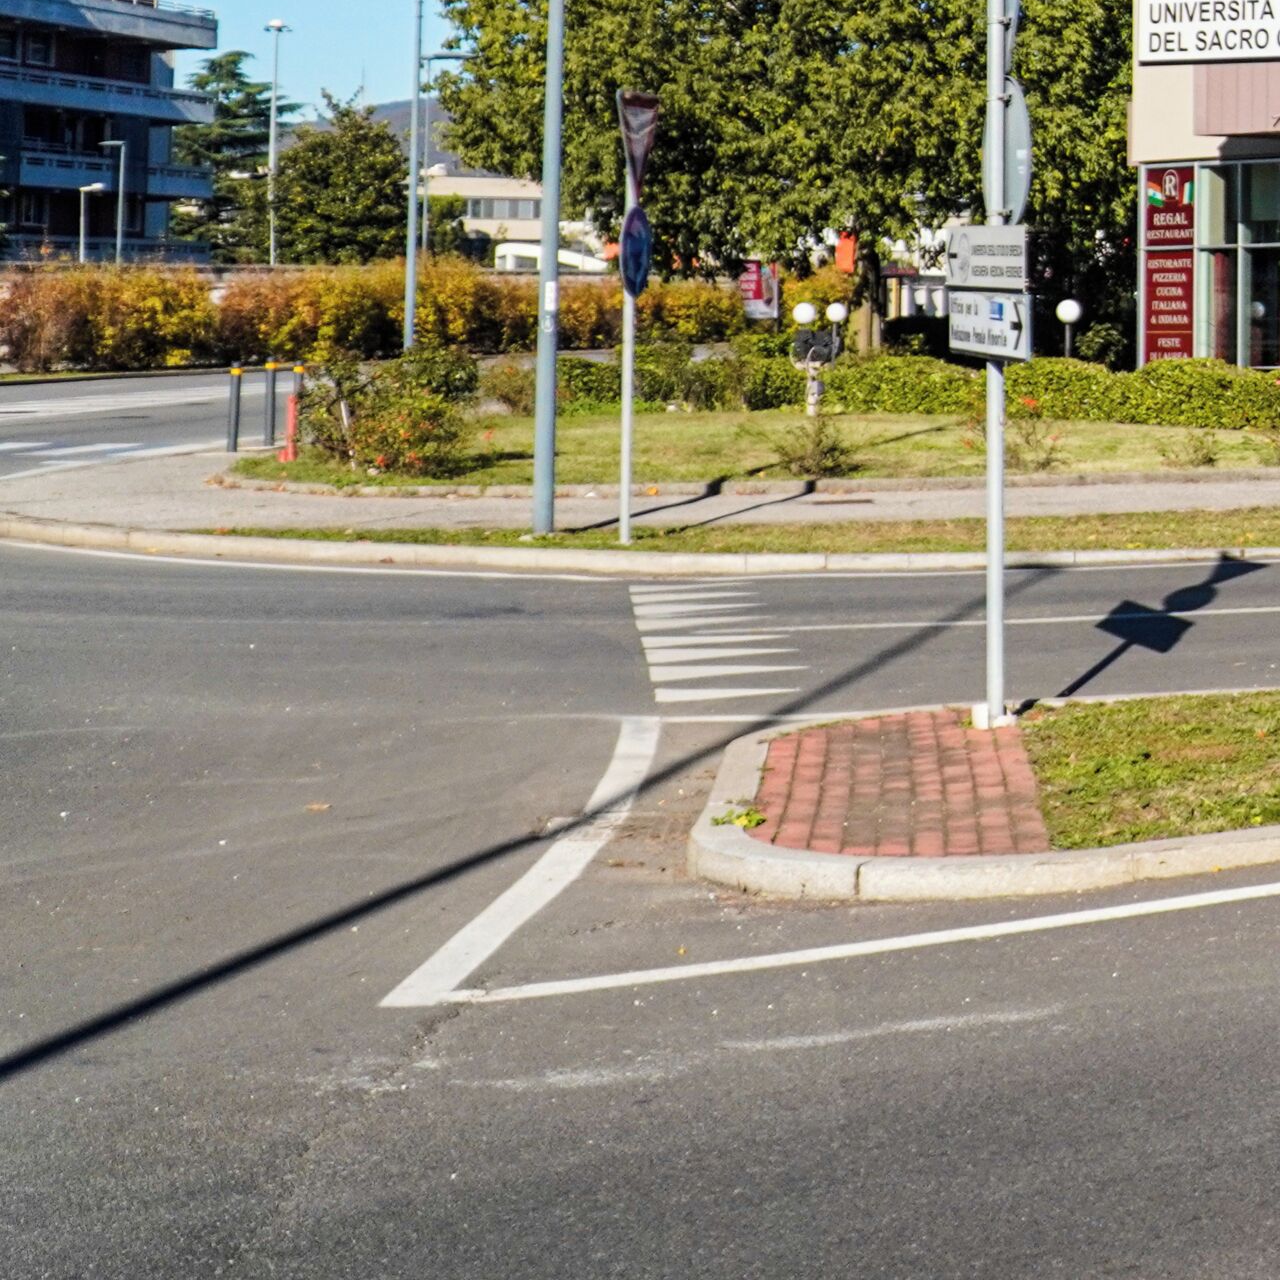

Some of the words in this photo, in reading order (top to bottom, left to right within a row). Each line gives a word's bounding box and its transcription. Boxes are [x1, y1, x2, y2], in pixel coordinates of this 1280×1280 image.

[1149, 31, 1188, 53] DEL
[1195, 28, 1270, 51] SACRO
[1165, 175, 1176, 197] R
[1153, 212, 1188, 225] REGAL
